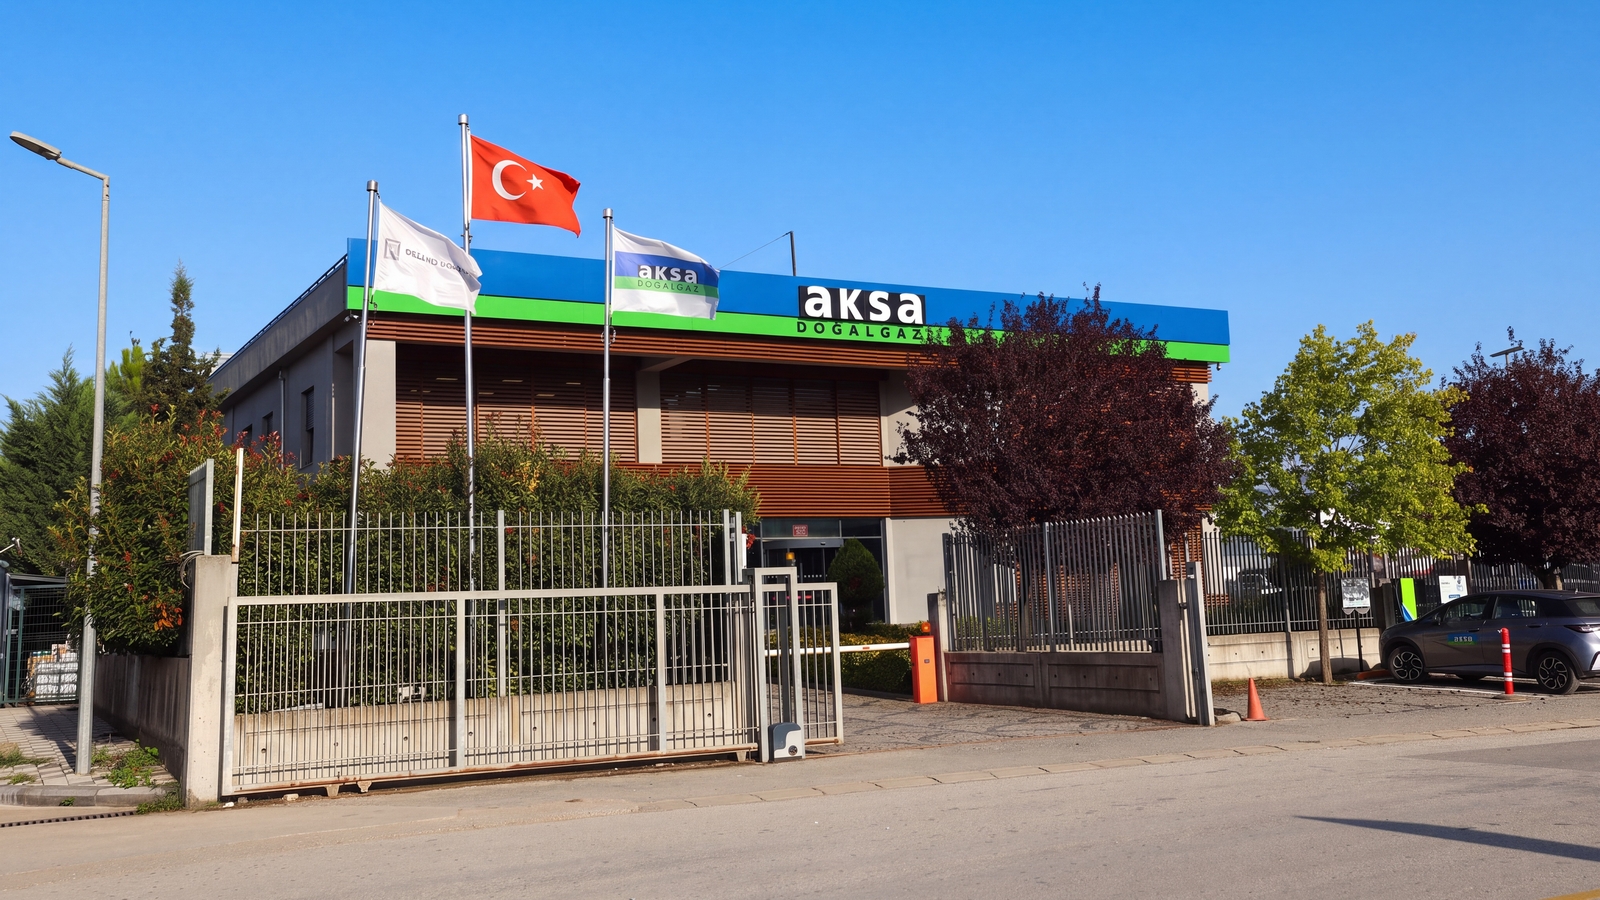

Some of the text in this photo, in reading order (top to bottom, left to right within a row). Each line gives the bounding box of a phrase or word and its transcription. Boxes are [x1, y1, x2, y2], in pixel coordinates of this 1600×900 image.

[638, 265, 697, 284] aksa
[804, 285, 923, 325] aksa
[796, 321, 922, 340] DOĞALGAZ
